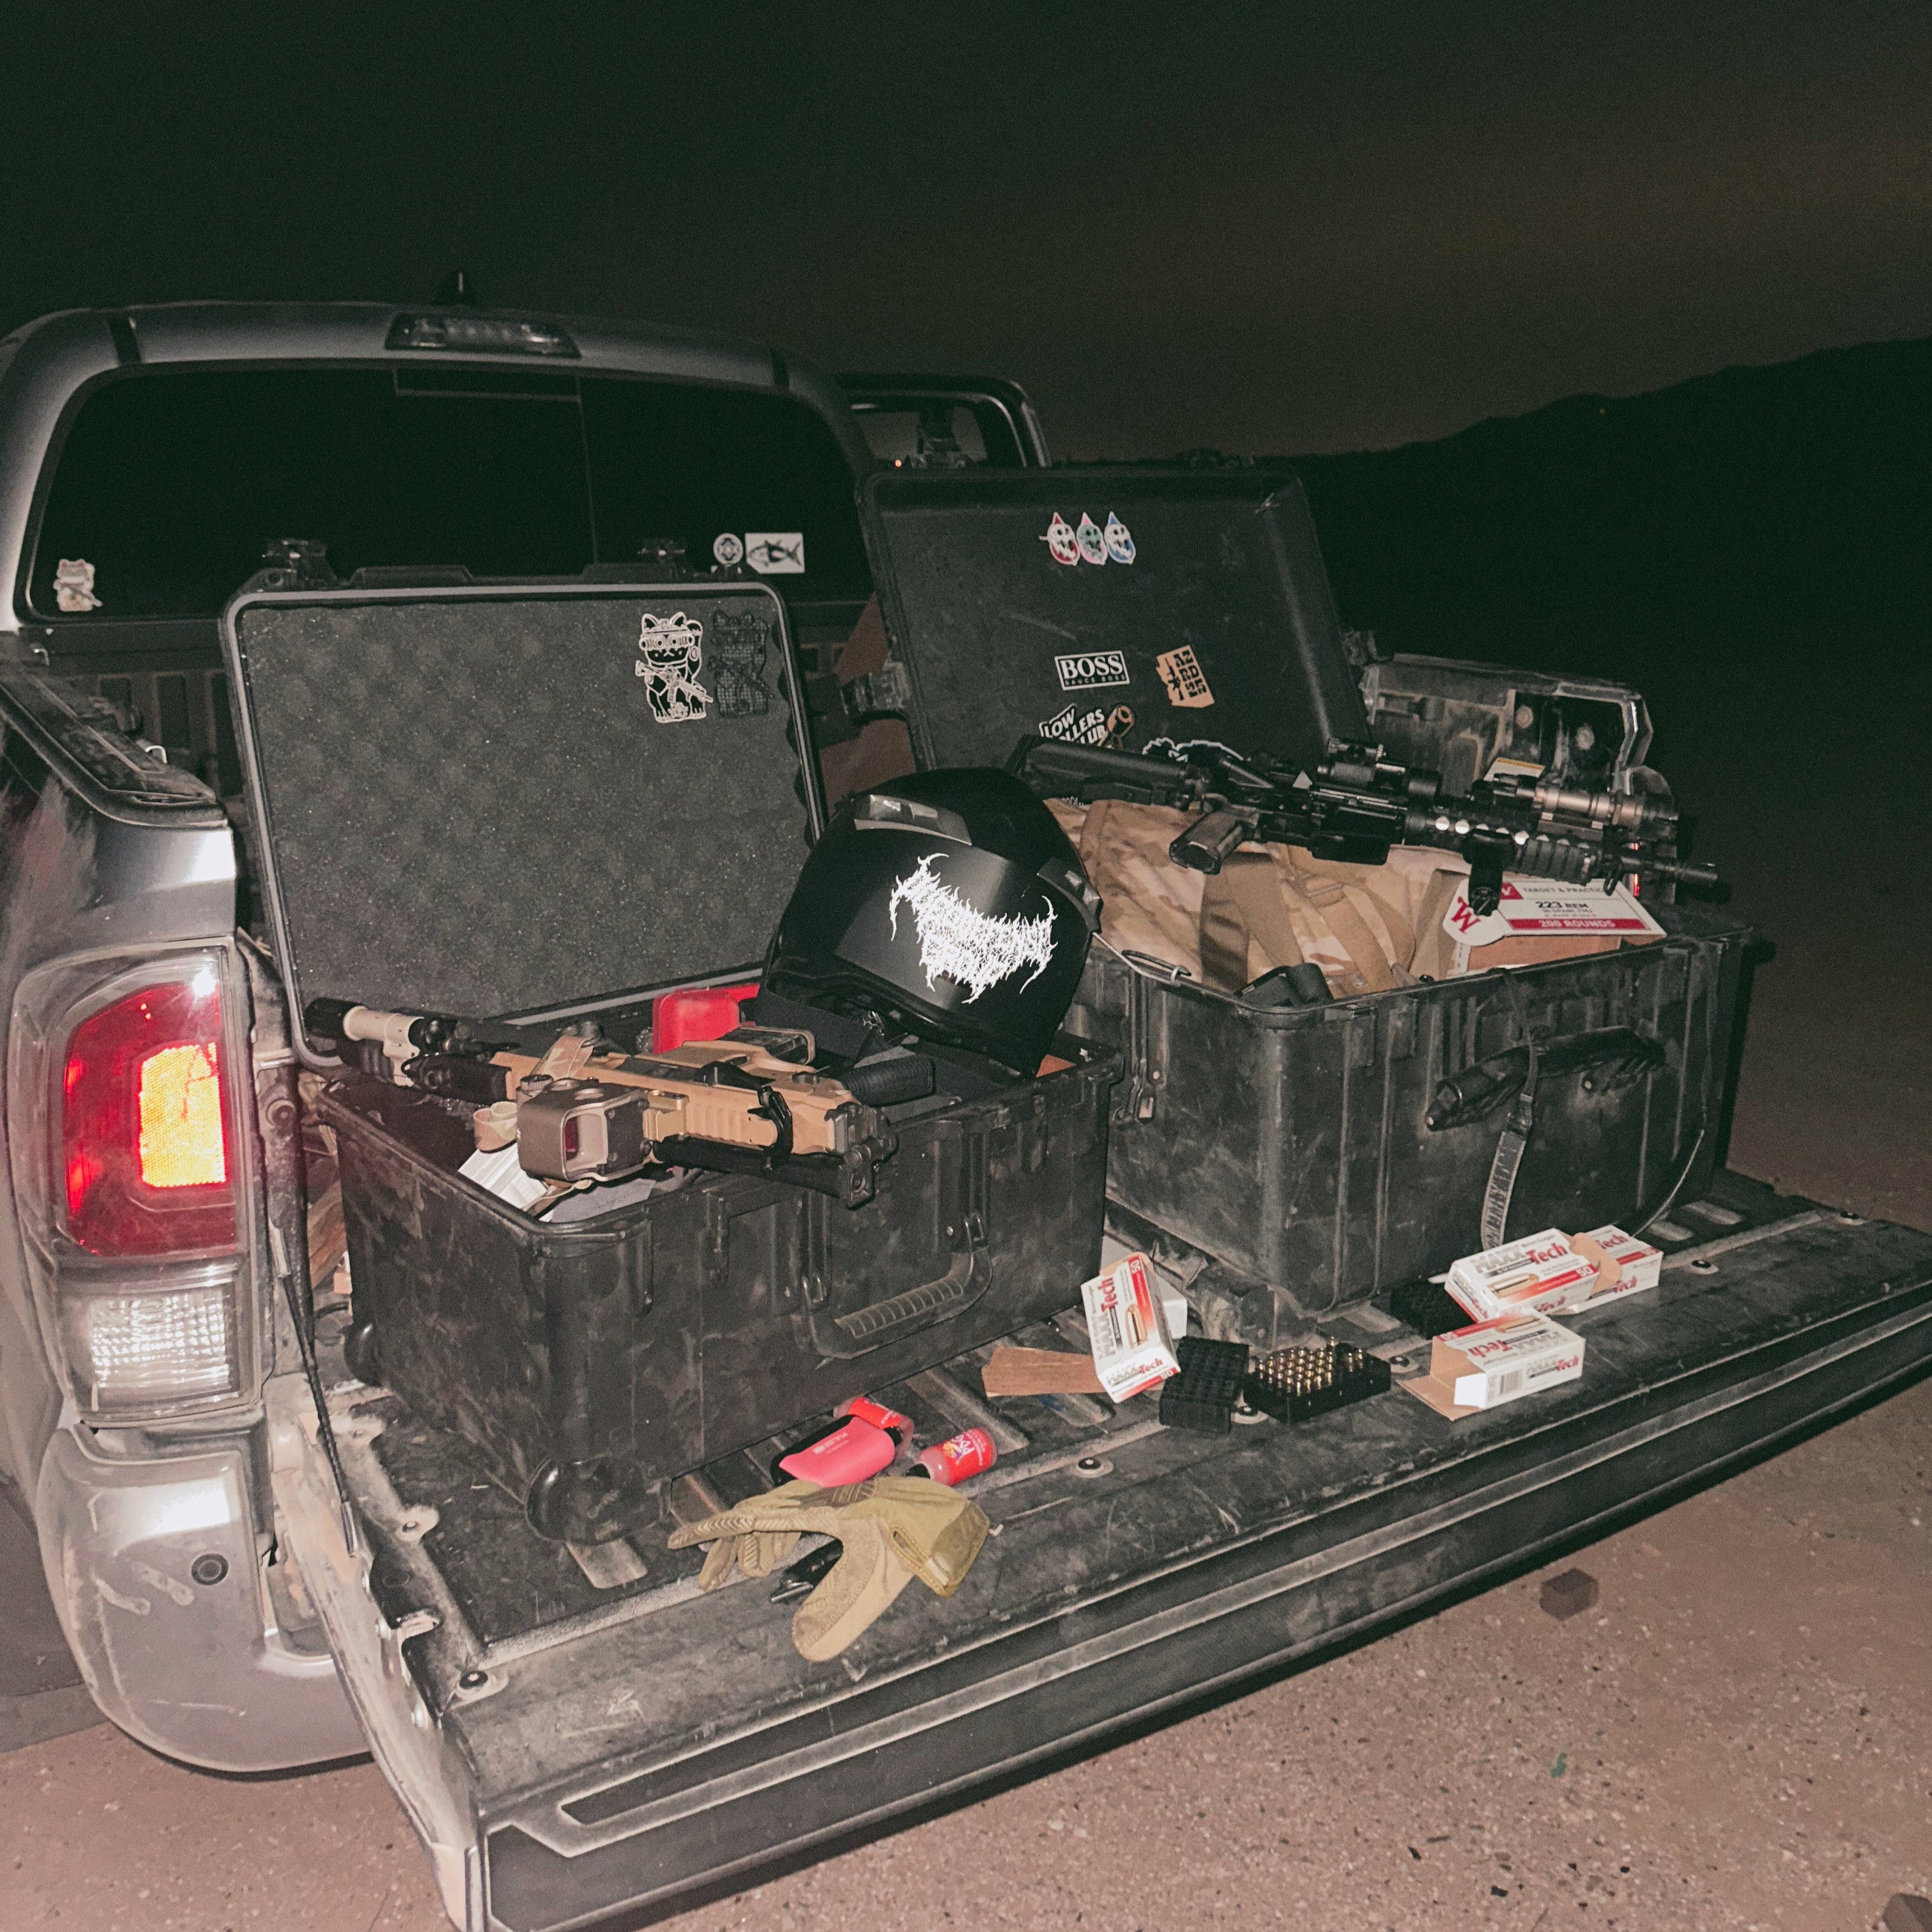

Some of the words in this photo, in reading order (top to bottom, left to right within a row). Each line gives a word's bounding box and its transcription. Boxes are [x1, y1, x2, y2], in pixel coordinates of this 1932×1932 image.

[1059, 655, 1123, 679] BOSS
[1044, 709, 1075, 738] LOW
[1452, 896, 1482, 934] W
[1526, 1243, 1568, 1265] Tech
[1130, 1259, 1142, 1274] 50
[1579, 1266, 1593, 1276] 50
[1098, 1276, 1117, 1313] Tech
[1468, 1340, 1512, 1358] Tech
[1138, 1358, 1163, 1374] Tech
